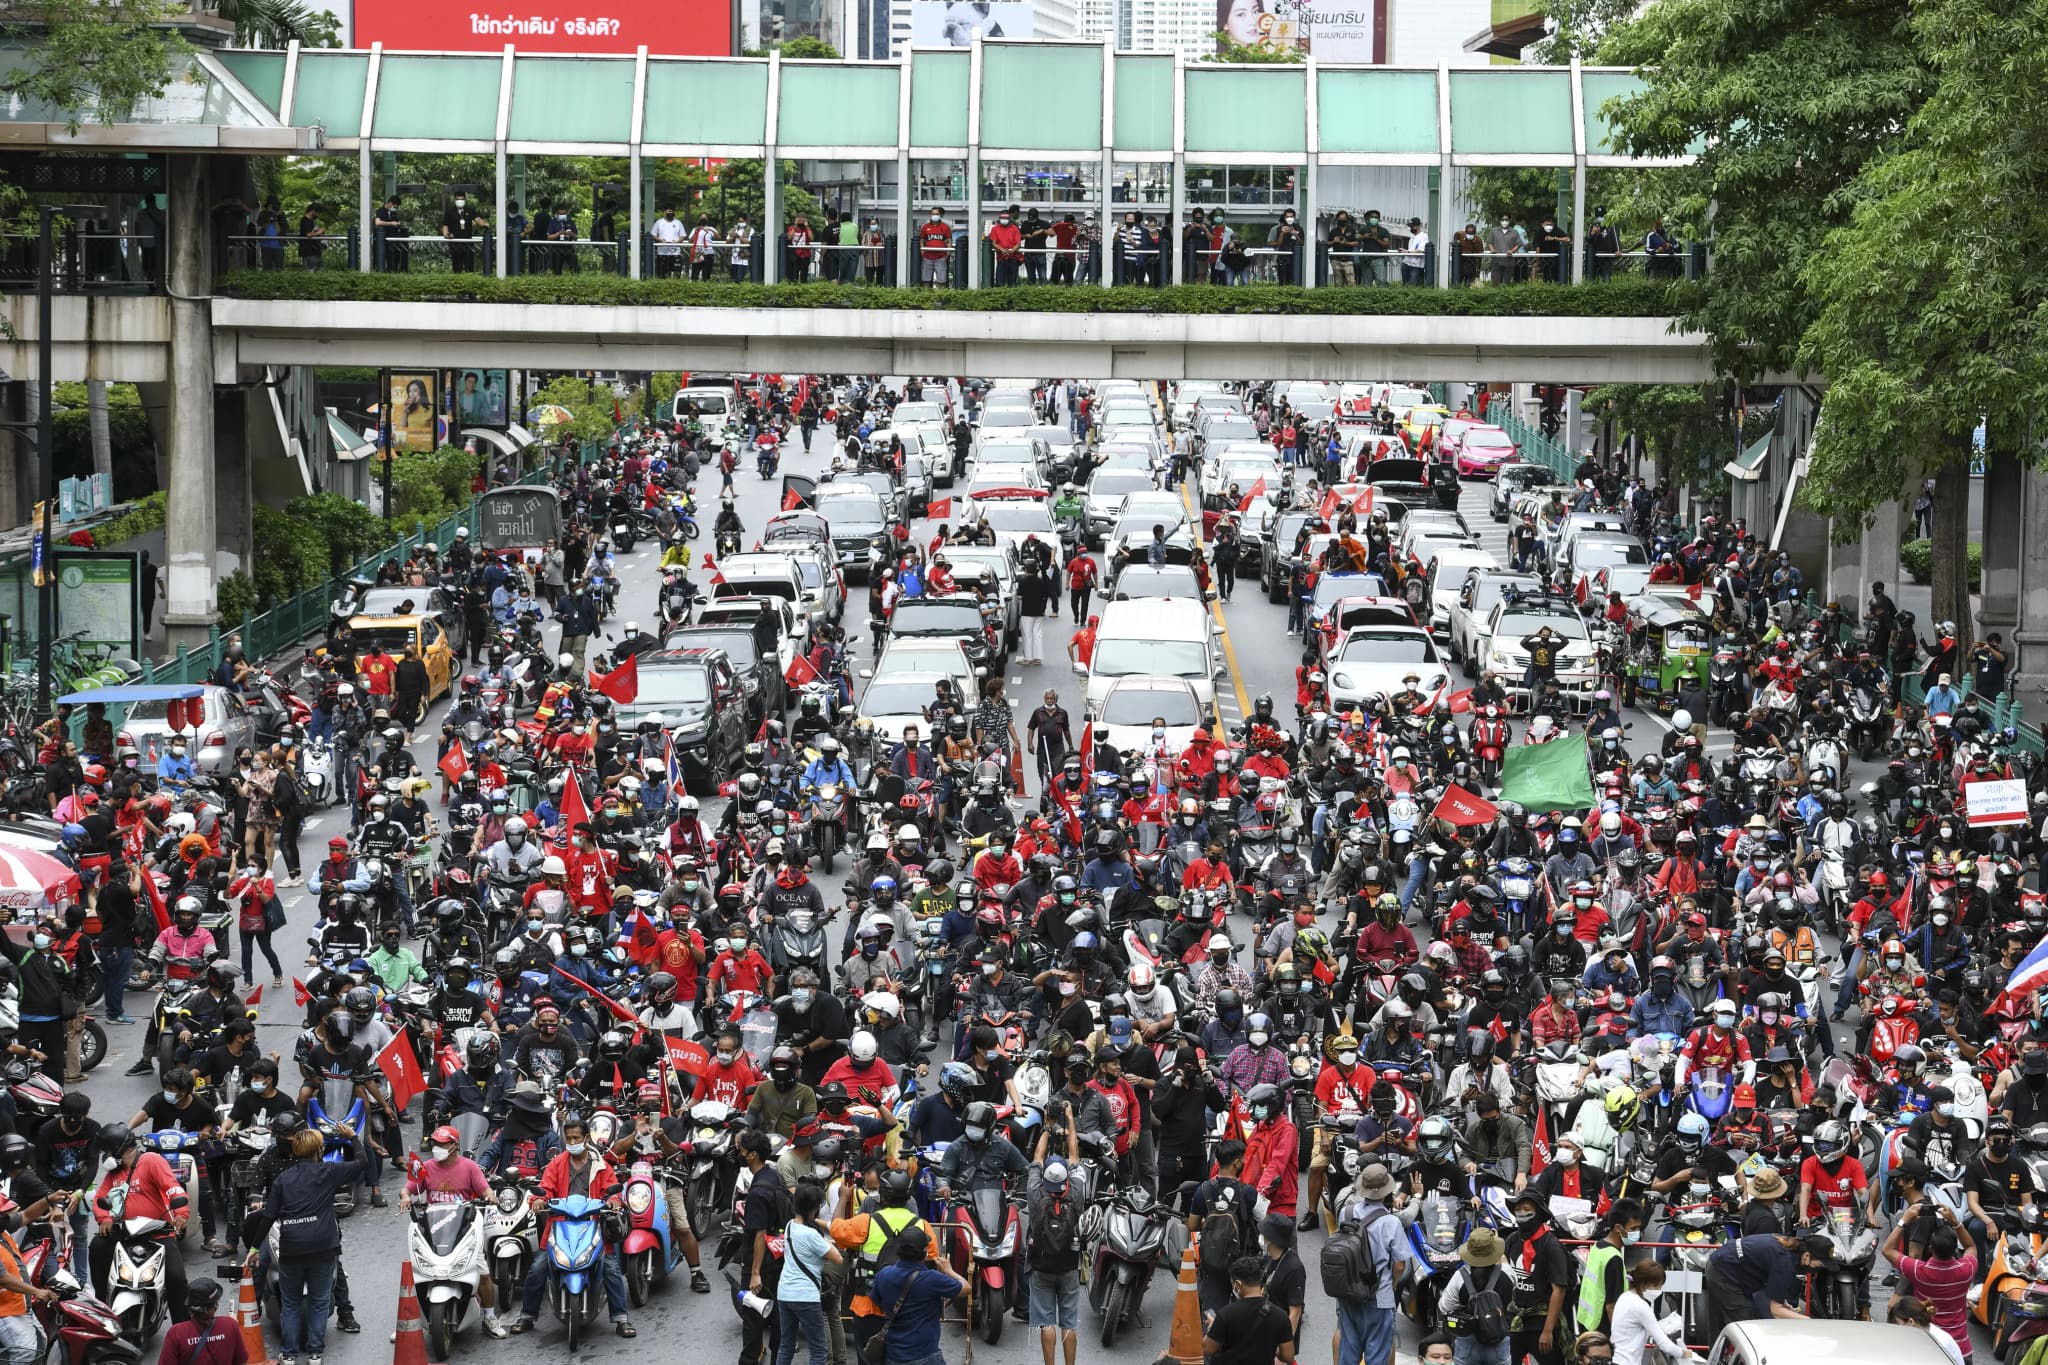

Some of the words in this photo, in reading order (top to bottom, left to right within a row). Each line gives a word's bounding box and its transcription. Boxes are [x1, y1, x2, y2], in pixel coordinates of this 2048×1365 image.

[497, 513, 534, 536] ออกไป
[776, 893, 810, 904] OCEAN
[208, 1333, 225, 1343] news
